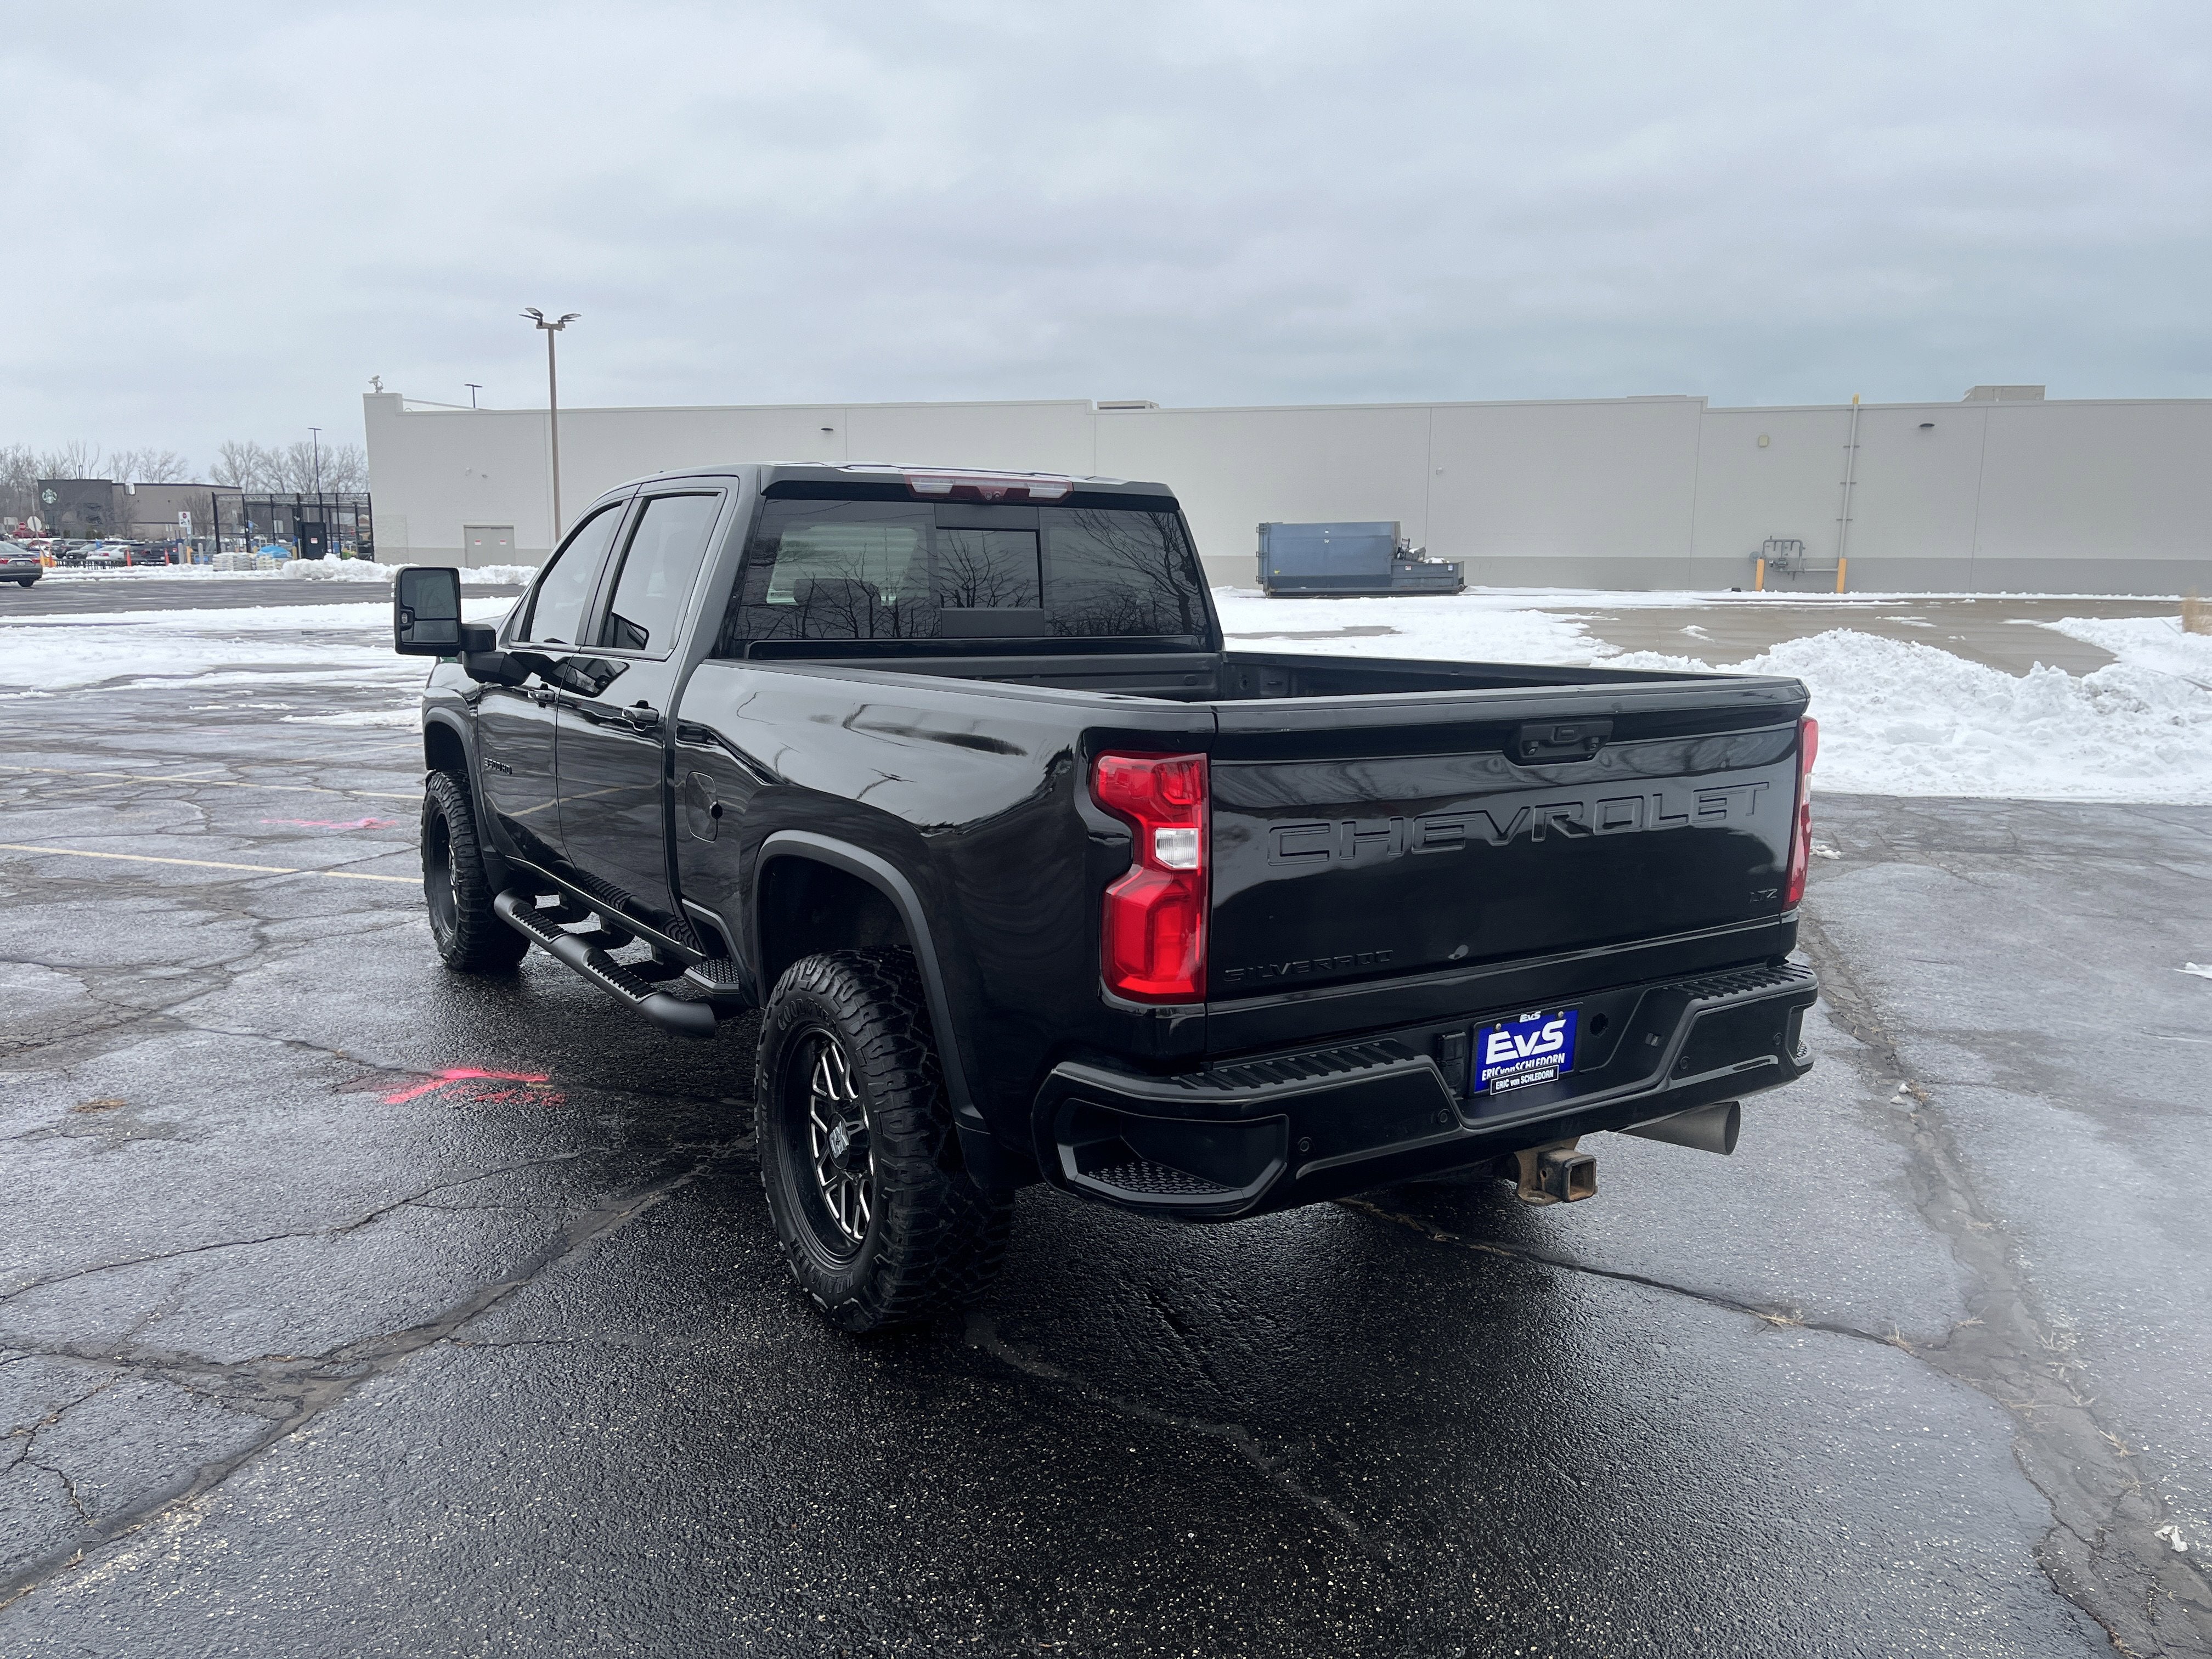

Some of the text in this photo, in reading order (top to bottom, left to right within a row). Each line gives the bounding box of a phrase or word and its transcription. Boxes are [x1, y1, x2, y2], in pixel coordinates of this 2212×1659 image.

[1268, 782, 1770, 865] CHEVROLET
[1749, 889, 1778, 903] LTZ
[1224, 950, 1393, 982] SILVERADO
[1496, 1069, 1554, 1090] ERIC von SCHLEDORN
